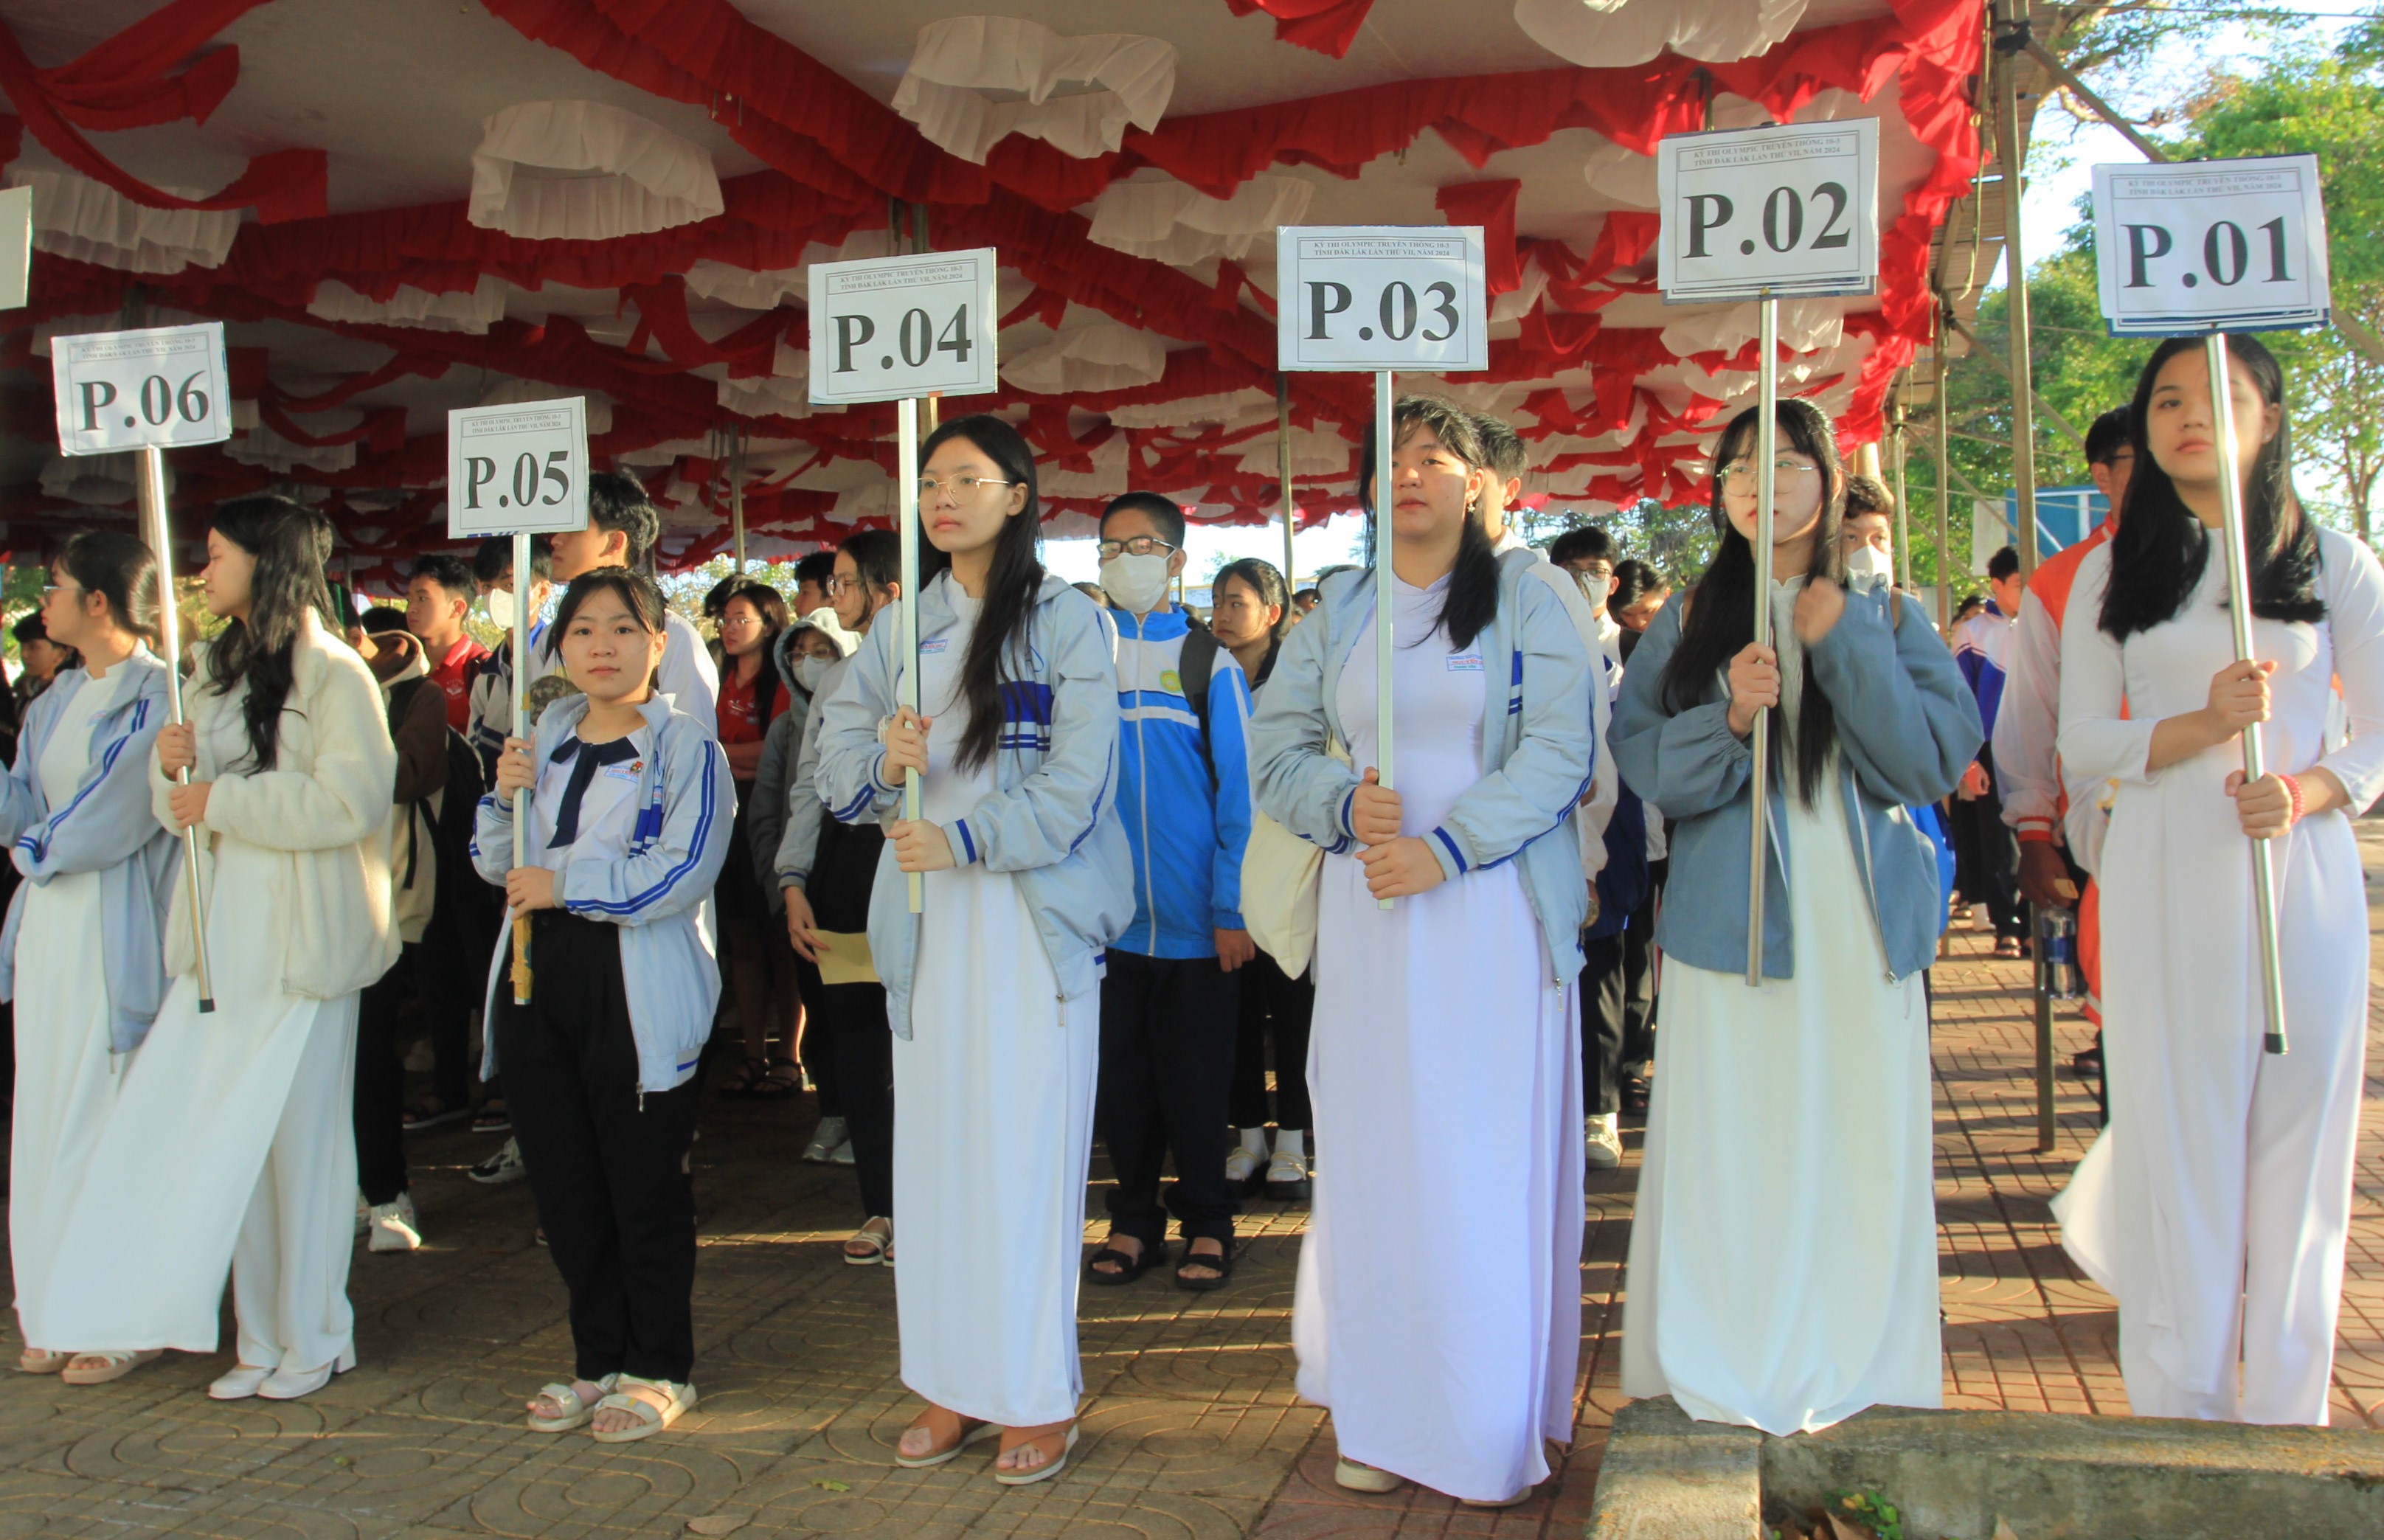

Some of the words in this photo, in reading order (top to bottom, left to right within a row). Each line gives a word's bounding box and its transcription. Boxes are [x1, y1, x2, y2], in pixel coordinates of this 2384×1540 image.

[1722, 146, 1758, 155] OLYMPIC
[1682, 181, 1851, 258] P.02
[864, 272, 893, 280] OLYMPIC
[2120, 216, 2298, 288] P.01
[831, 303, 971, 372] P.04
[1303, 281, 1459, 341] P.03
[75, 370, 209, 431] P.06
[464, 451, 569, 509] P.05
